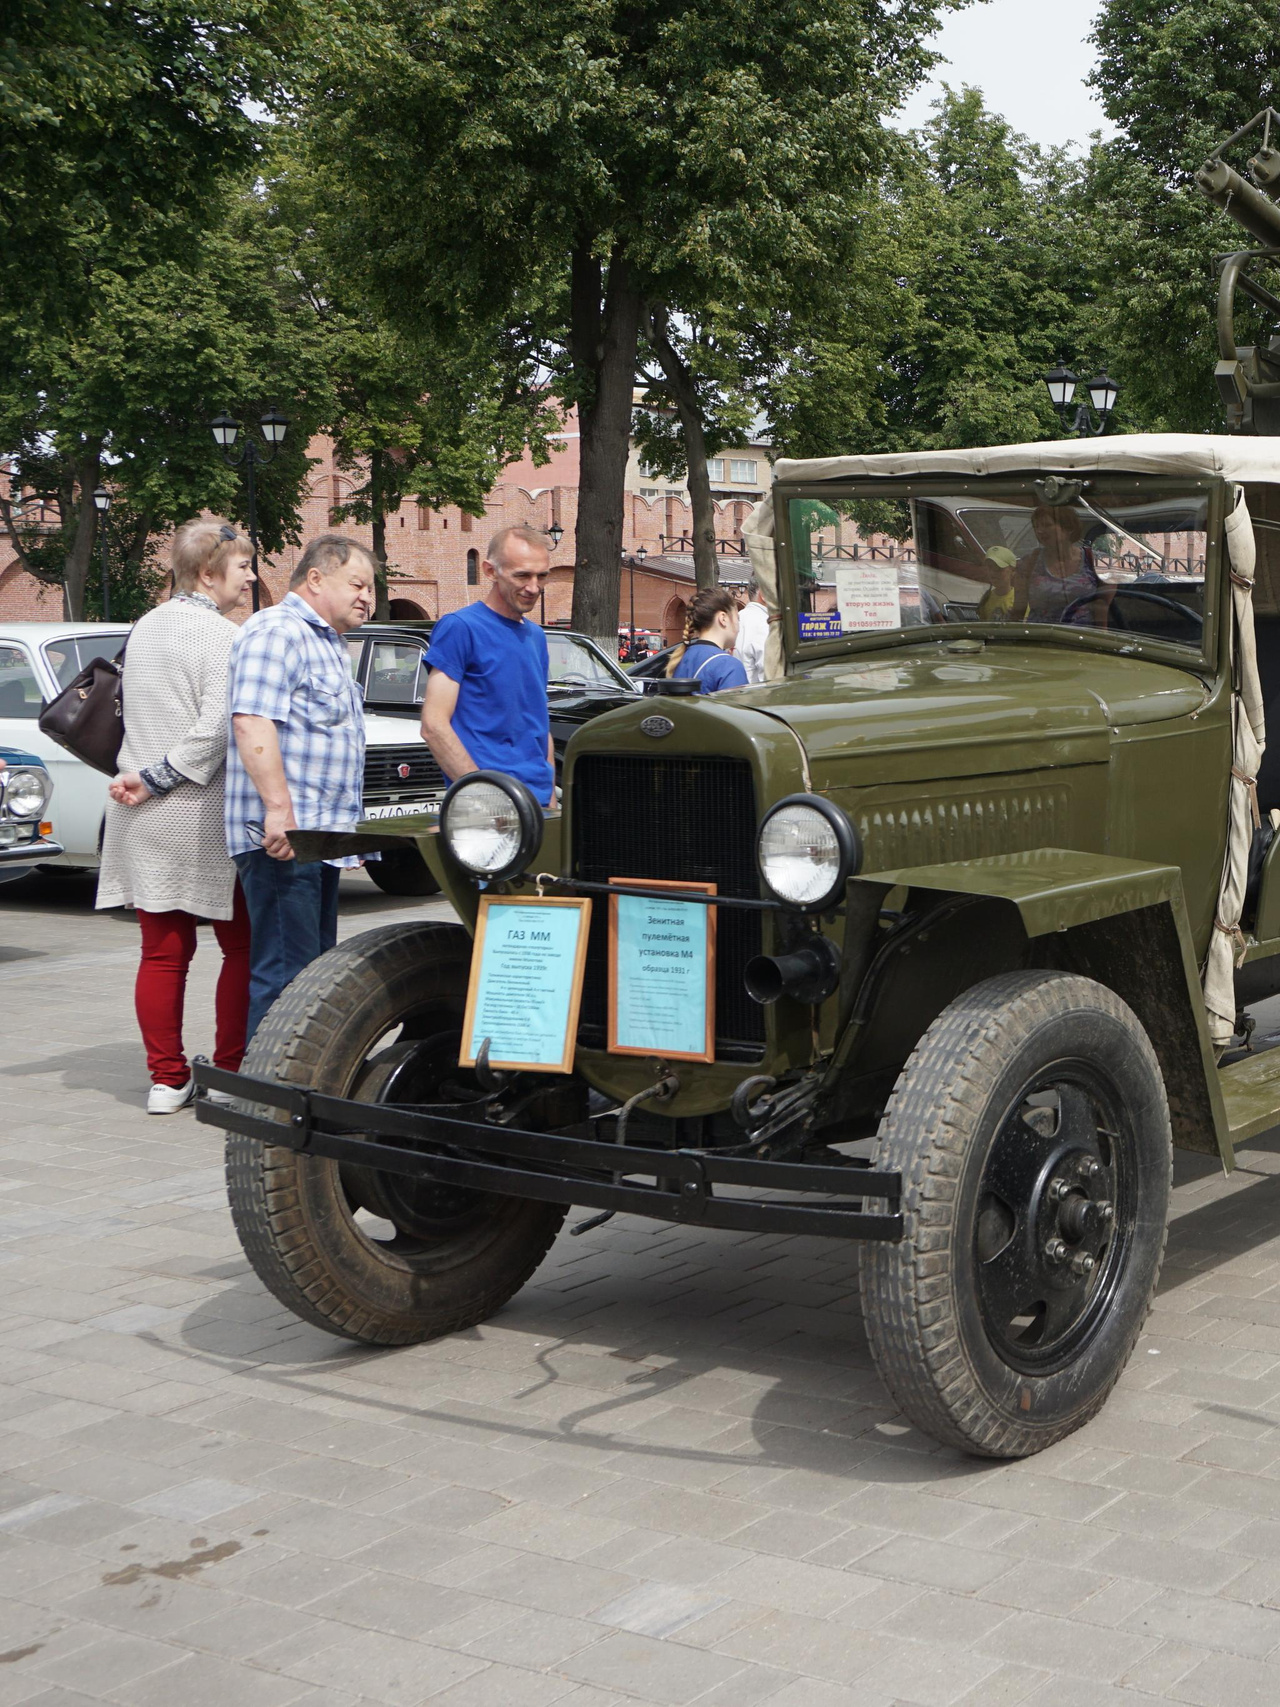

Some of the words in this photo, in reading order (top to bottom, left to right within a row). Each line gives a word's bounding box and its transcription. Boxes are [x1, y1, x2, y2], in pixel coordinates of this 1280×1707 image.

[829, 621, 841, 629] 777
[647, 915, 685, 926] Зенитная
[507, 930, 525, 939] ГАЗ
[530, 931, 551, 940] ММ
[641, 933, 690, 944] пулемётная
[638, 948, 679, 960] установка
[681, 949, 693, 959] М4
[642, 964, 669, 975] образца
[671, 965, 687, 974] 1931
